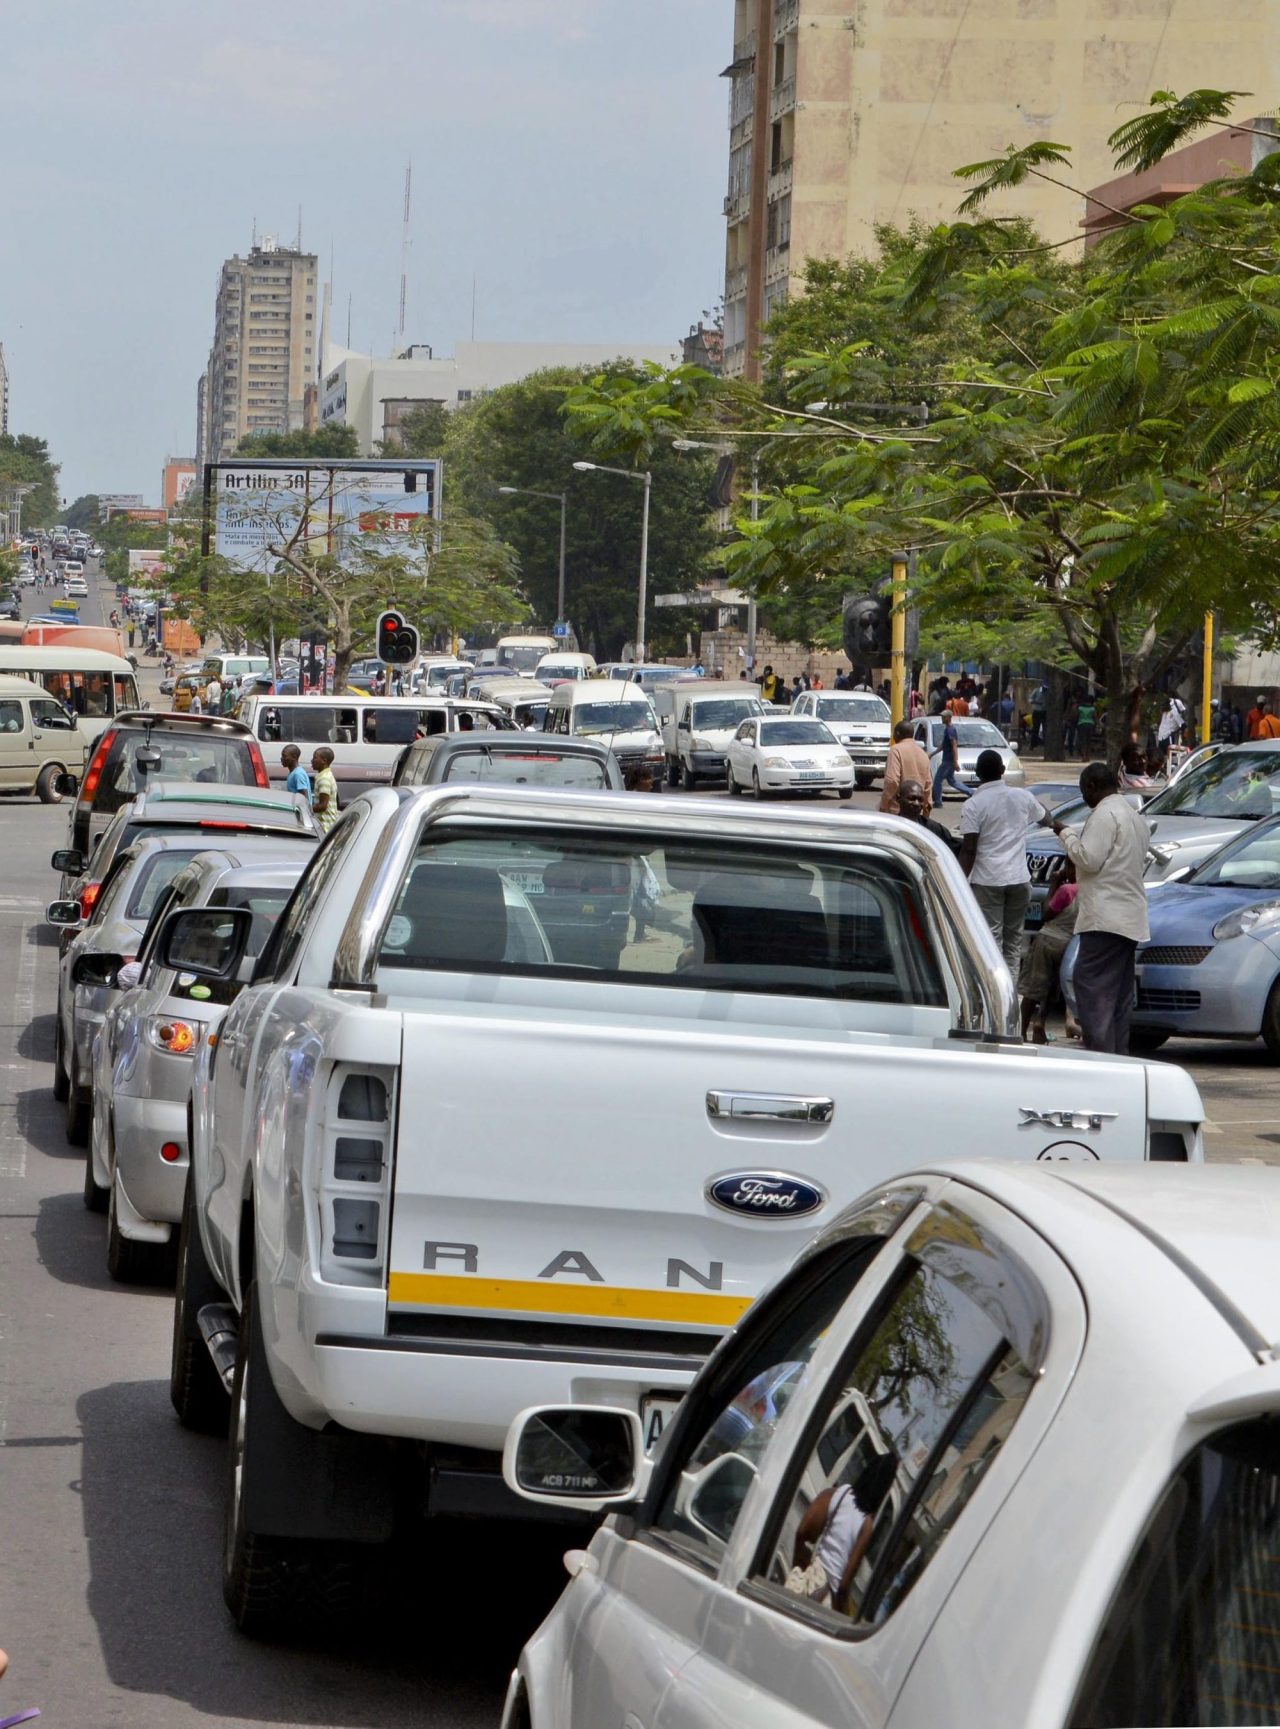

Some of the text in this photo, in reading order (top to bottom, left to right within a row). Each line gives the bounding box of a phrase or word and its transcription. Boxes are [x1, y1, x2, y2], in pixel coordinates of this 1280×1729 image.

[225, 474, 304, 489] Artilin 3A
[733, 1178, 799, 1208] Ford
